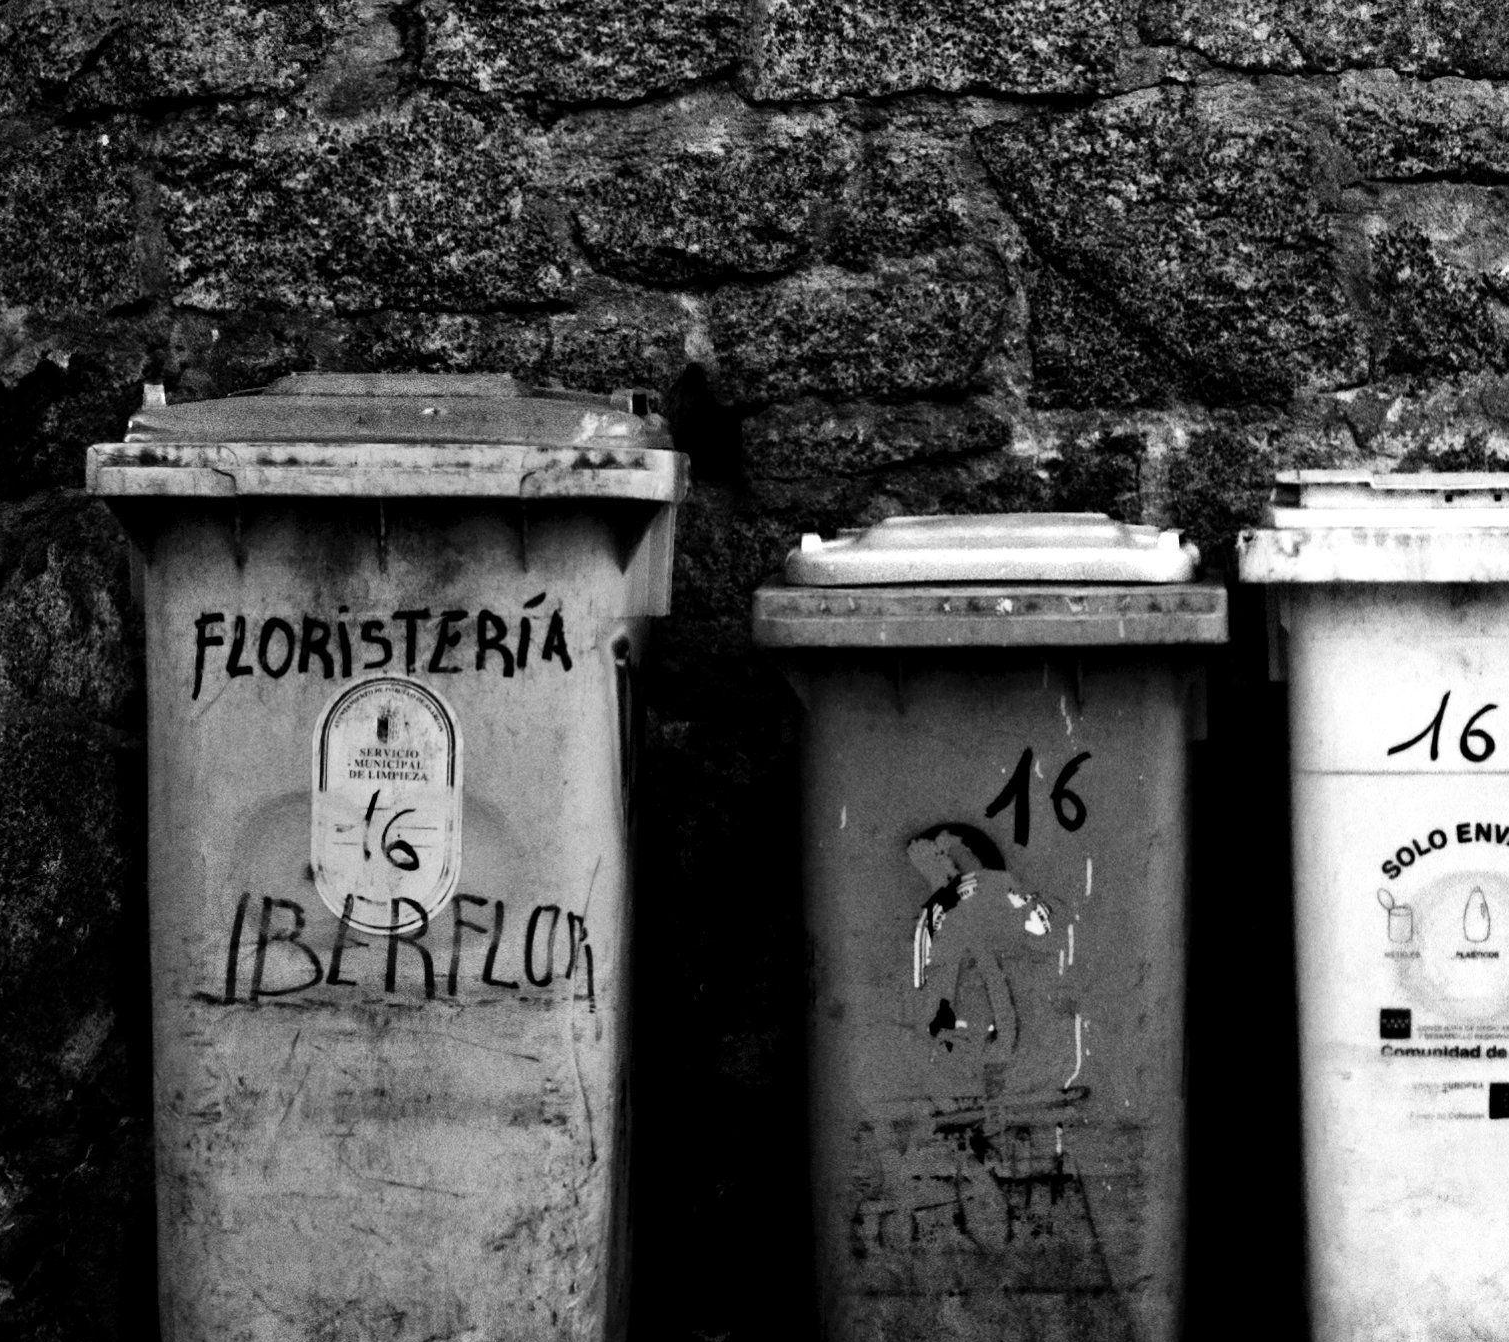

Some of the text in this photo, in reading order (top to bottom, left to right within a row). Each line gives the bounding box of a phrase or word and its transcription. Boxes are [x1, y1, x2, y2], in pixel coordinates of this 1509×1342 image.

[1387, 689, 1498, 763] 16
[349, 769, 428, 781] DE LIMPIEZA
[354, 758, 423, 770] MUNICIPAL
[359, 747, 419, 759] SERVICIO
[984, 747, 1092, 846] 16
[363, 789, 419, 871] 16
[1381, 828, 1448, 880] SOLO
[224, 893, 595, 1011] IBERFLOR
[1381, 1044, 1481, 1058] Comunidad
[1486, 1044, 1507, 1058] de
